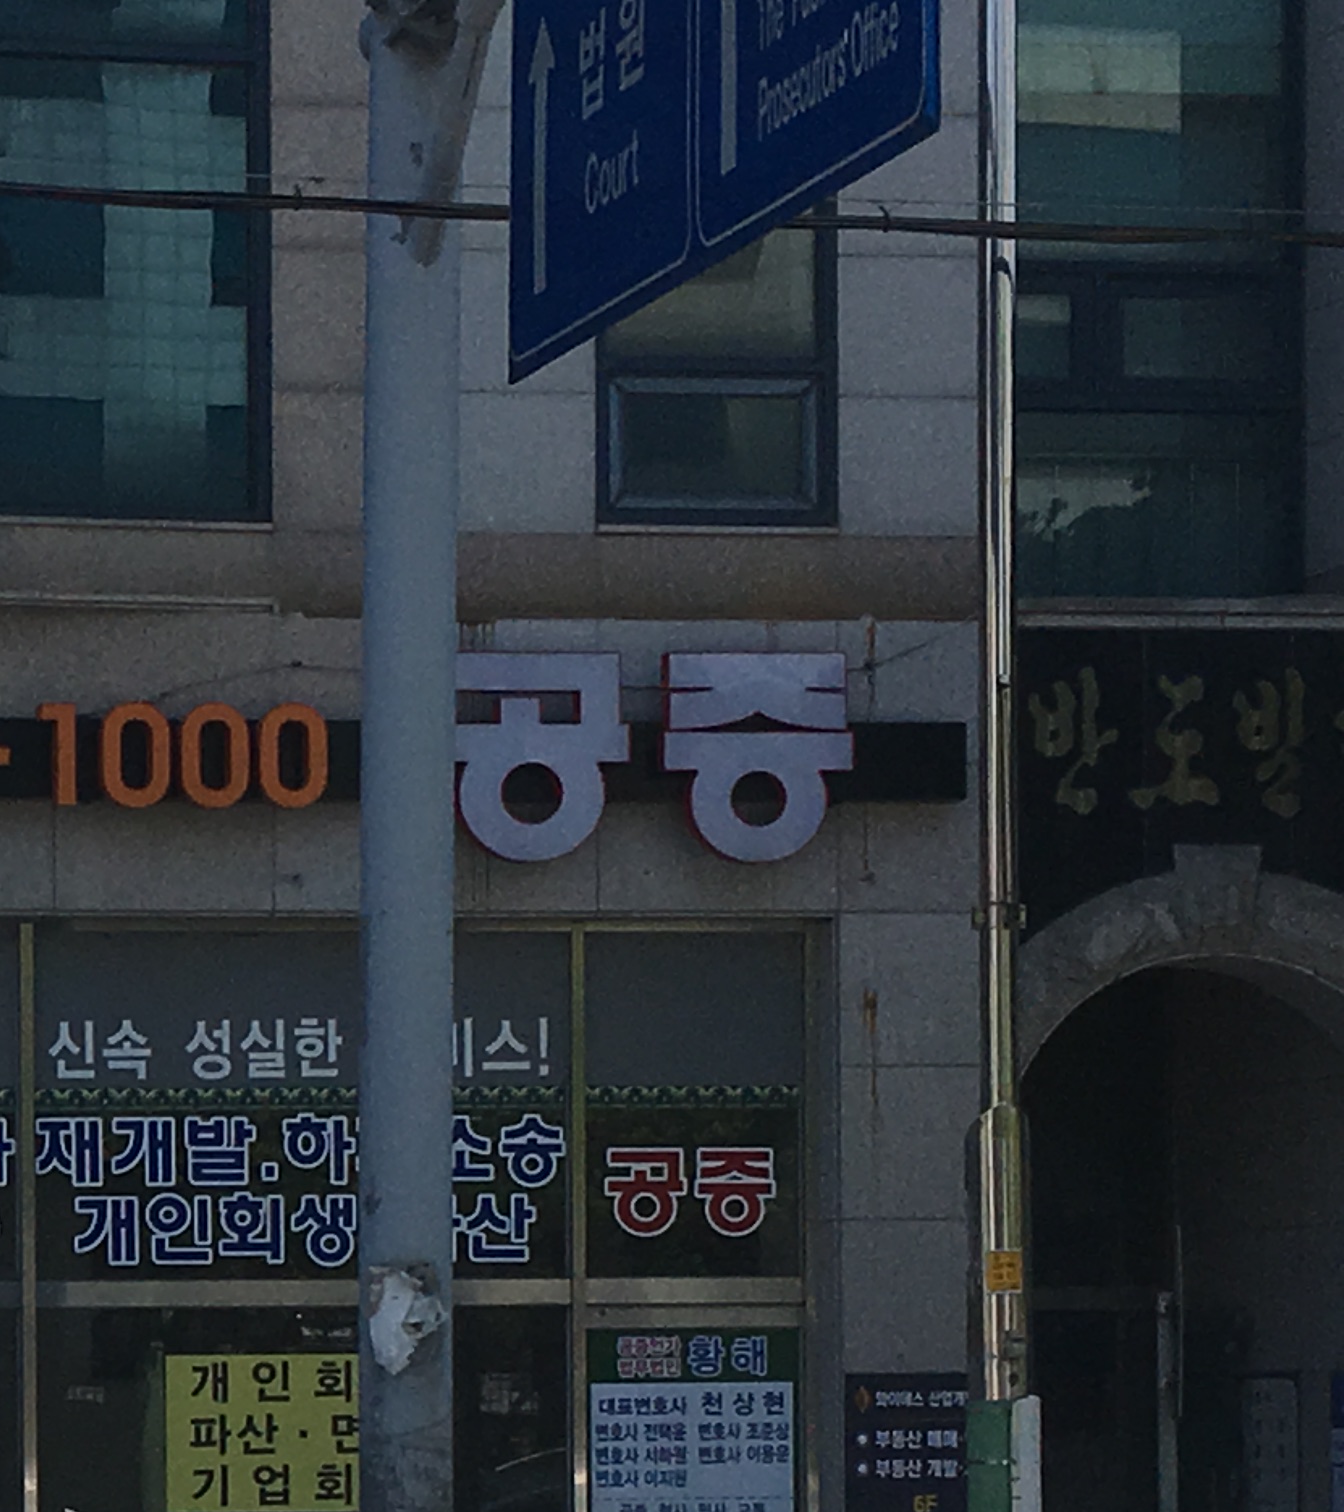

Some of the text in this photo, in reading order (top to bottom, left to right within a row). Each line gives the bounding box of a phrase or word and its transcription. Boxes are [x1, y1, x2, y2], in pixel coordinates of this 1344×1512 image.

[579, 0, 645, 120] 법원
[850, 0, 900, 78] Office
[584, 129, 640, 214] Court
[454, 651, 856, 864] 공증
[1028, 666, 1344, 819] 반도빌
[48, 1019, 152, 1080] 신속
[184, 1017, 343, 1080] 성실한
[604, 1146, 776, 1238] 공증
[191, 1360, 353, 1403] 개인회
[687, 1335, 768, 1378] 황해
[598, 1391, 785, 1417] 대표변호사 천상현
[875, 1429, 923, 1450] 부동산
[875, 1458, 923, 1479] 부동산
[192, 1463, 352, 1506] 기업회
